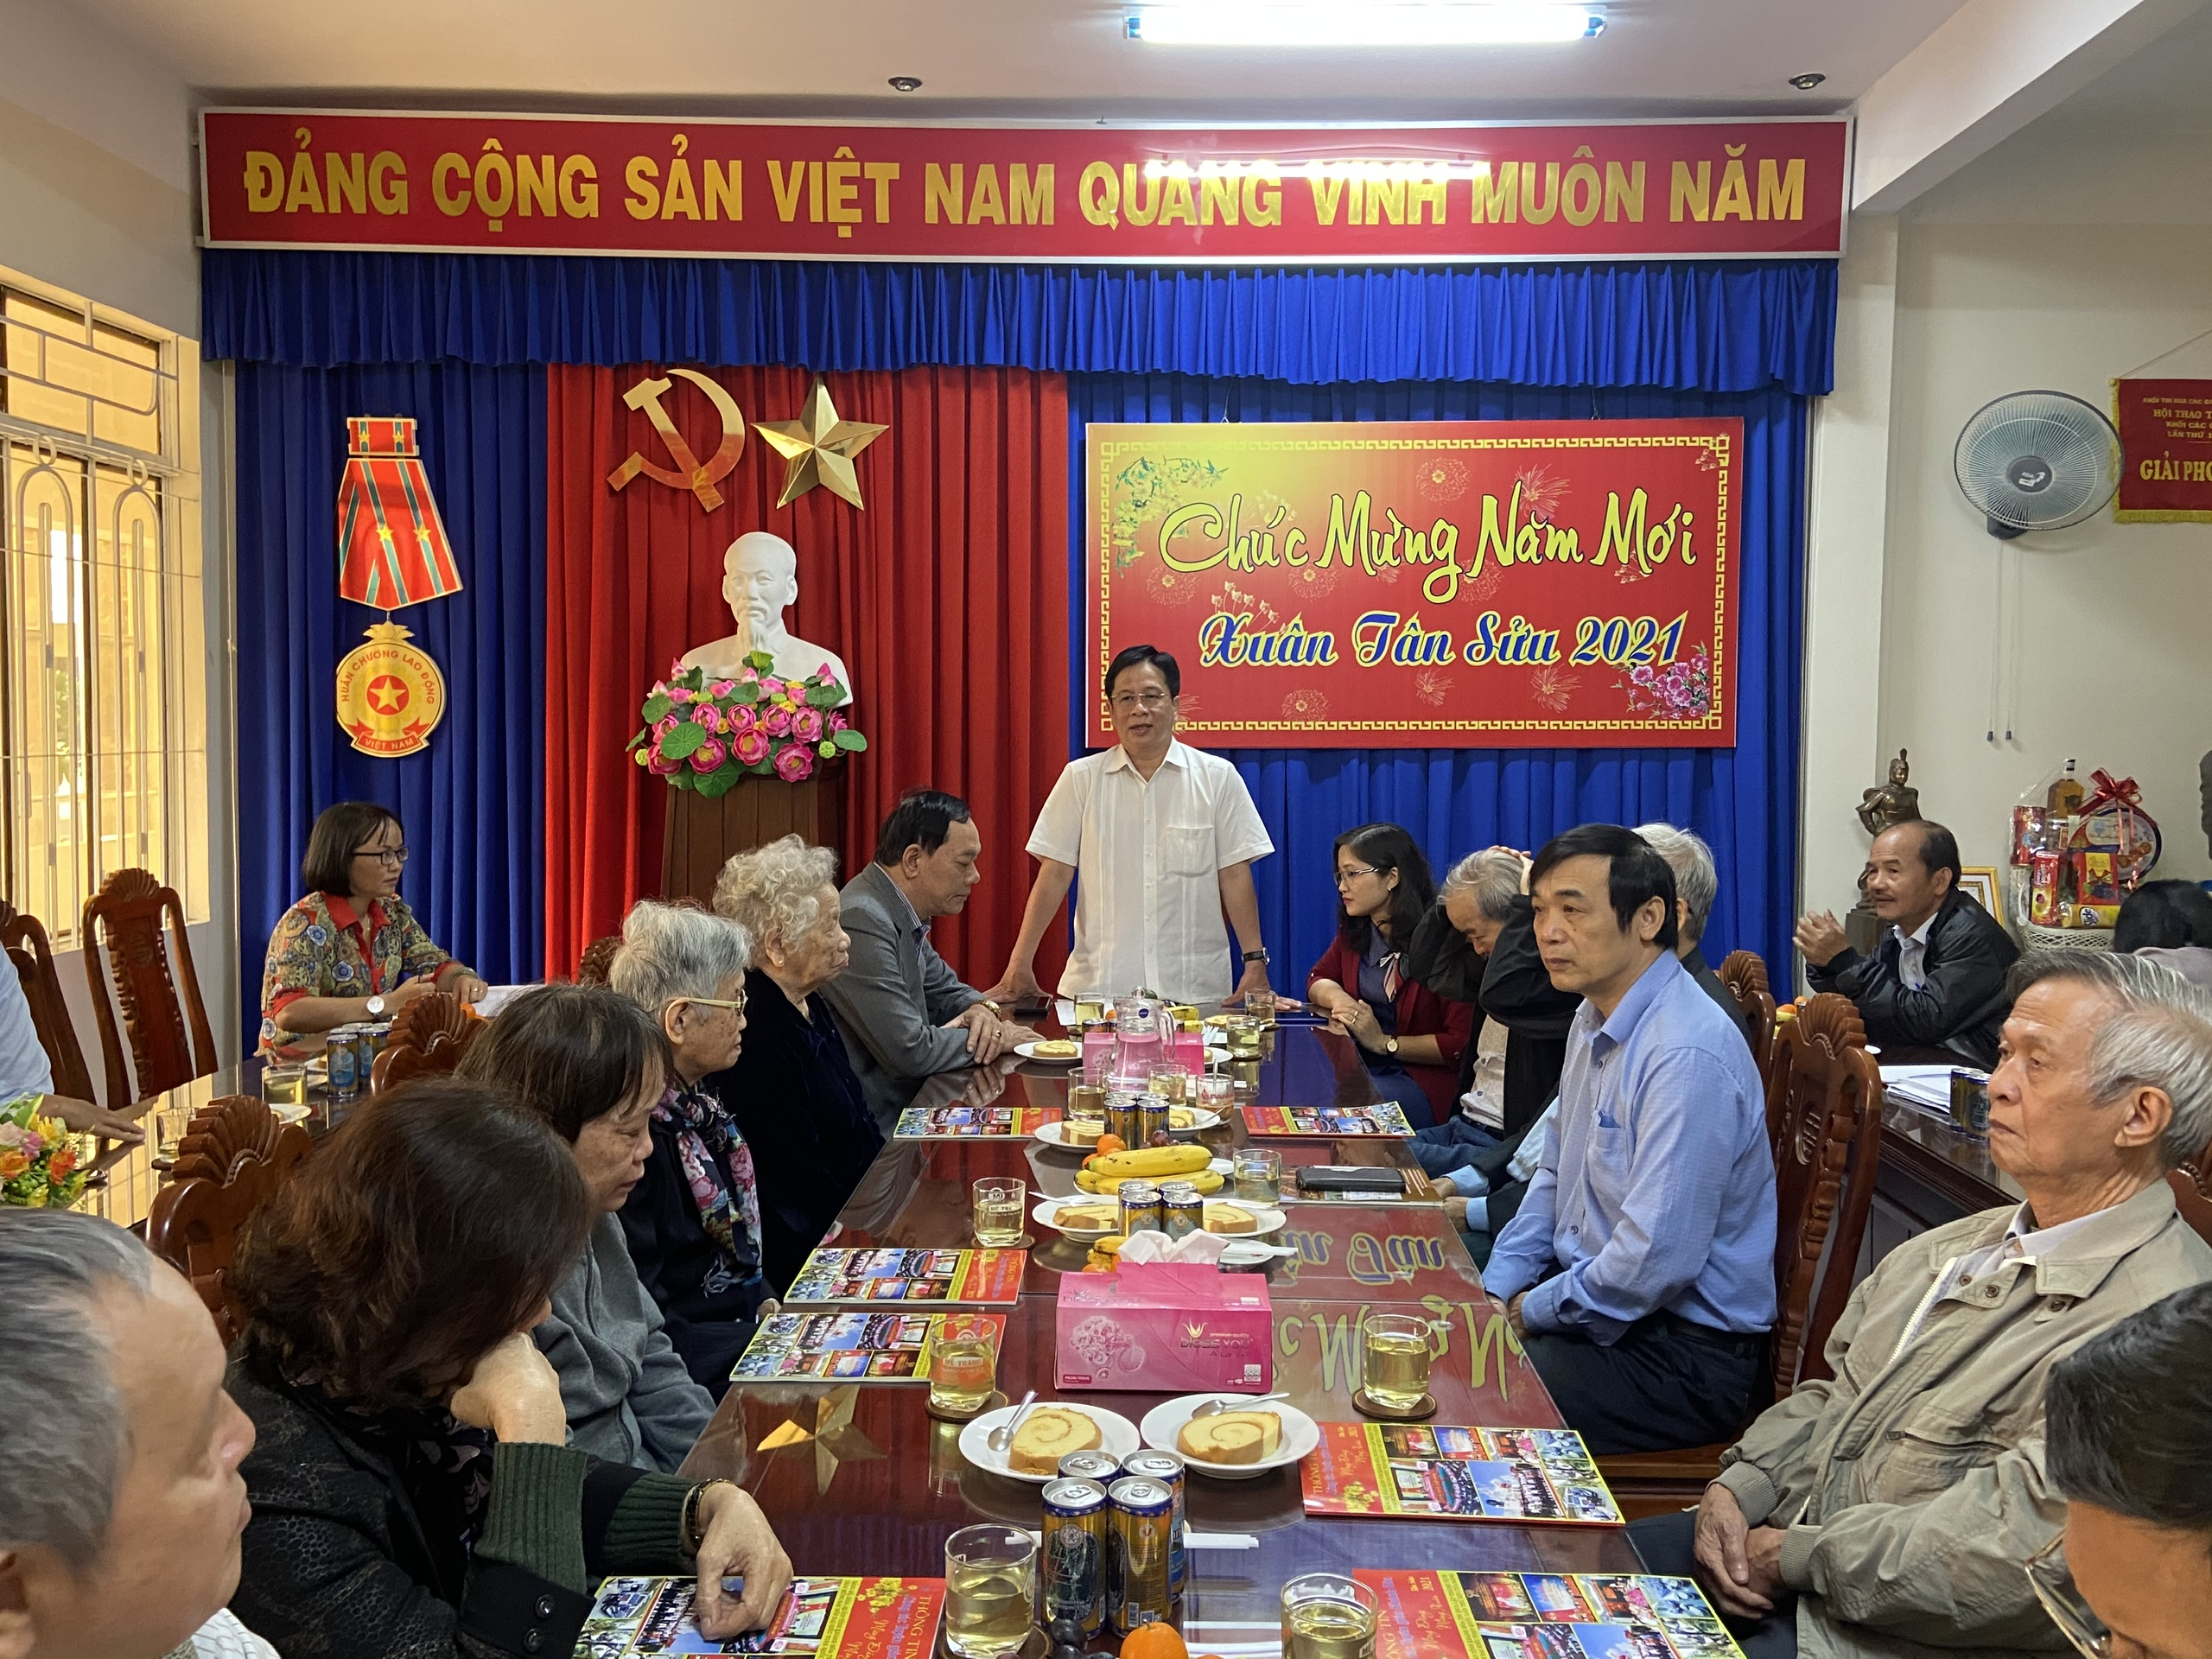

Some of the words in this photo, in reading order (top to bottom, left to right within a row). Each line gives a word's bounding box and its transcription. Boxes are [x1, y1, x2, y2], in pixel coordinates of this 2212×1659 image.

[245, 128, 408, 214] ĐẢNG
[431, 138, 599, 232] CỘNG
[624, 134, 742, 221] SẢN
[766, 146, 899, 238] VIỆT
[925, 163, 1054, 226] NAM
[1078, 161, 1281, 231] QUANG
[1308, 162, 1447, 226] VINH
[1472, 145, 1644, 226] MUÔN
[1669, 143, 1804, 222] NĂM
[2153, 408, 2172, 419] HỘI
[2139, 450, 2180, 480] GIẢI
[1159, 493, 1309, 574] Chúc
[1316, 490, 1458, 603] Mừng
[1466, 480, 1583, 577] Năm
[1590, 486, 1697, 574] Mới
[1199, 610, 1338, 668] Xuân
[1351, 611, 1455, 668] Tân
[1465, 610, 1560, 668] Sửu
[1569, 610, 1689, 668] 2021
[340, 672, 355, 702] HUÂN
[403, 654, 422, 671] LAO
[421, 672, 435, 704] ĐỘNG
[365, 738, 386, 750] VIỆT
[391, 738, 414, 749] NAM
[1419, 1577, 1433, 1591] 2021
[911, 1596, 932, 1637] THÔNG
[1384, 1632, 1401, 1659] ÔNG
